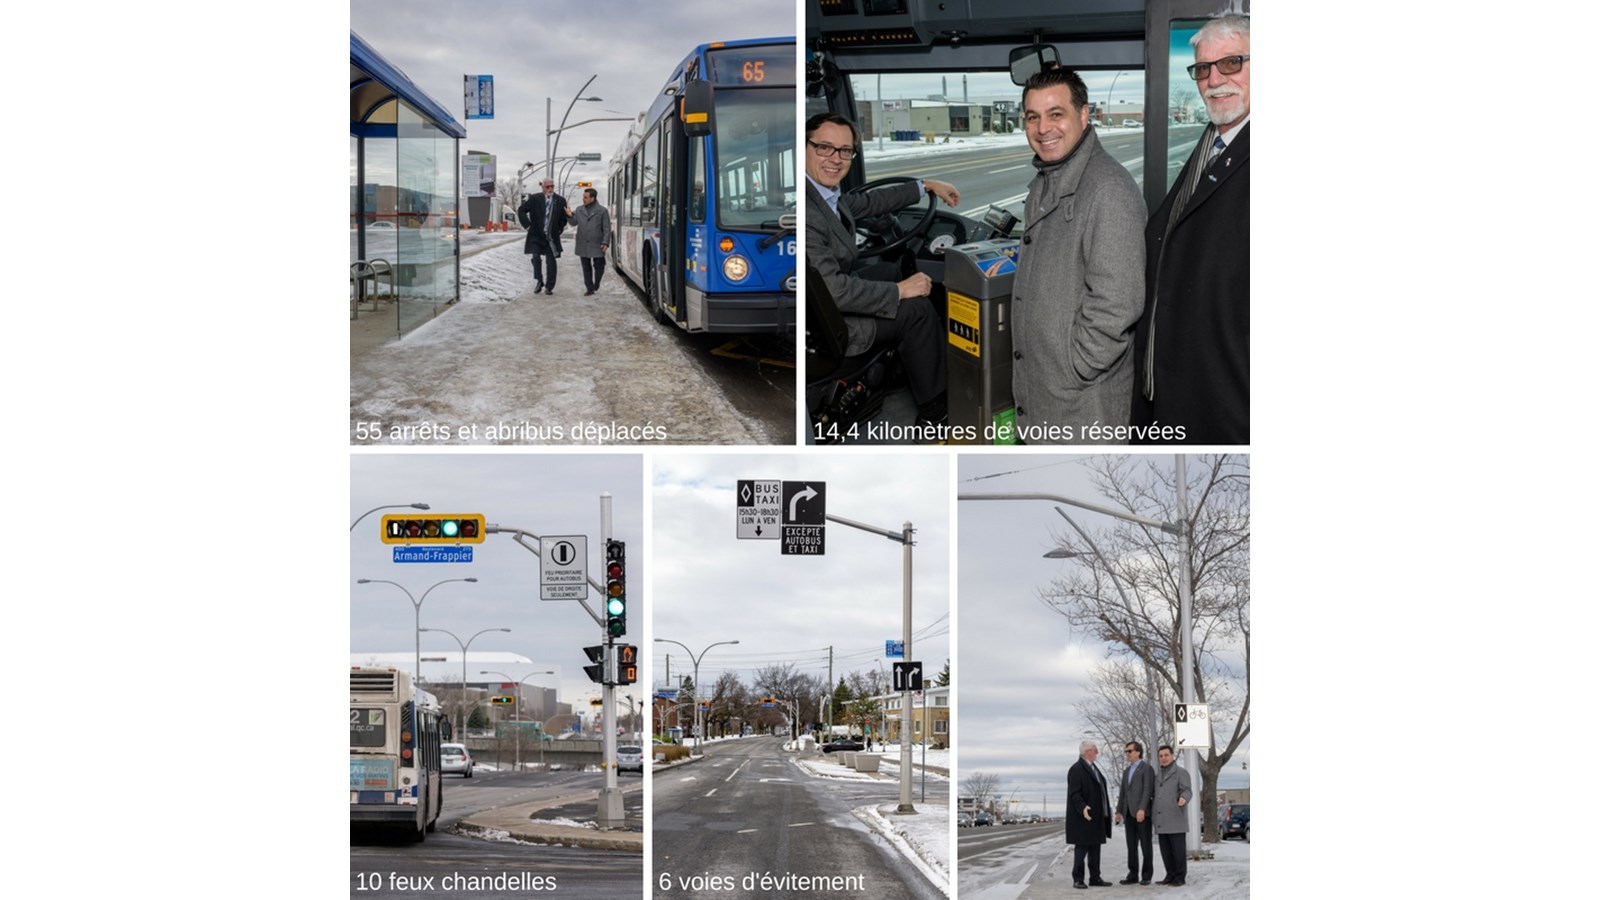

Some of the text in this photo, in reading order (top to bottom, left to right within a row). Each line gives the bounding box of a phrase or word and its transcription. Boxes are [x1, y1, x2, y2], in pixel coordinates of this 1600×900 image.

[743, 60, 765, 82] 65
[756, 484, 779, 493] BUS
[756, 496, 779, 504] TAXI
[785, 537, 821, 545] AUTOBUS
[789, 545, 818, 553] ET TAXI
[395, 551, 472, 563] Armand-Frappier
